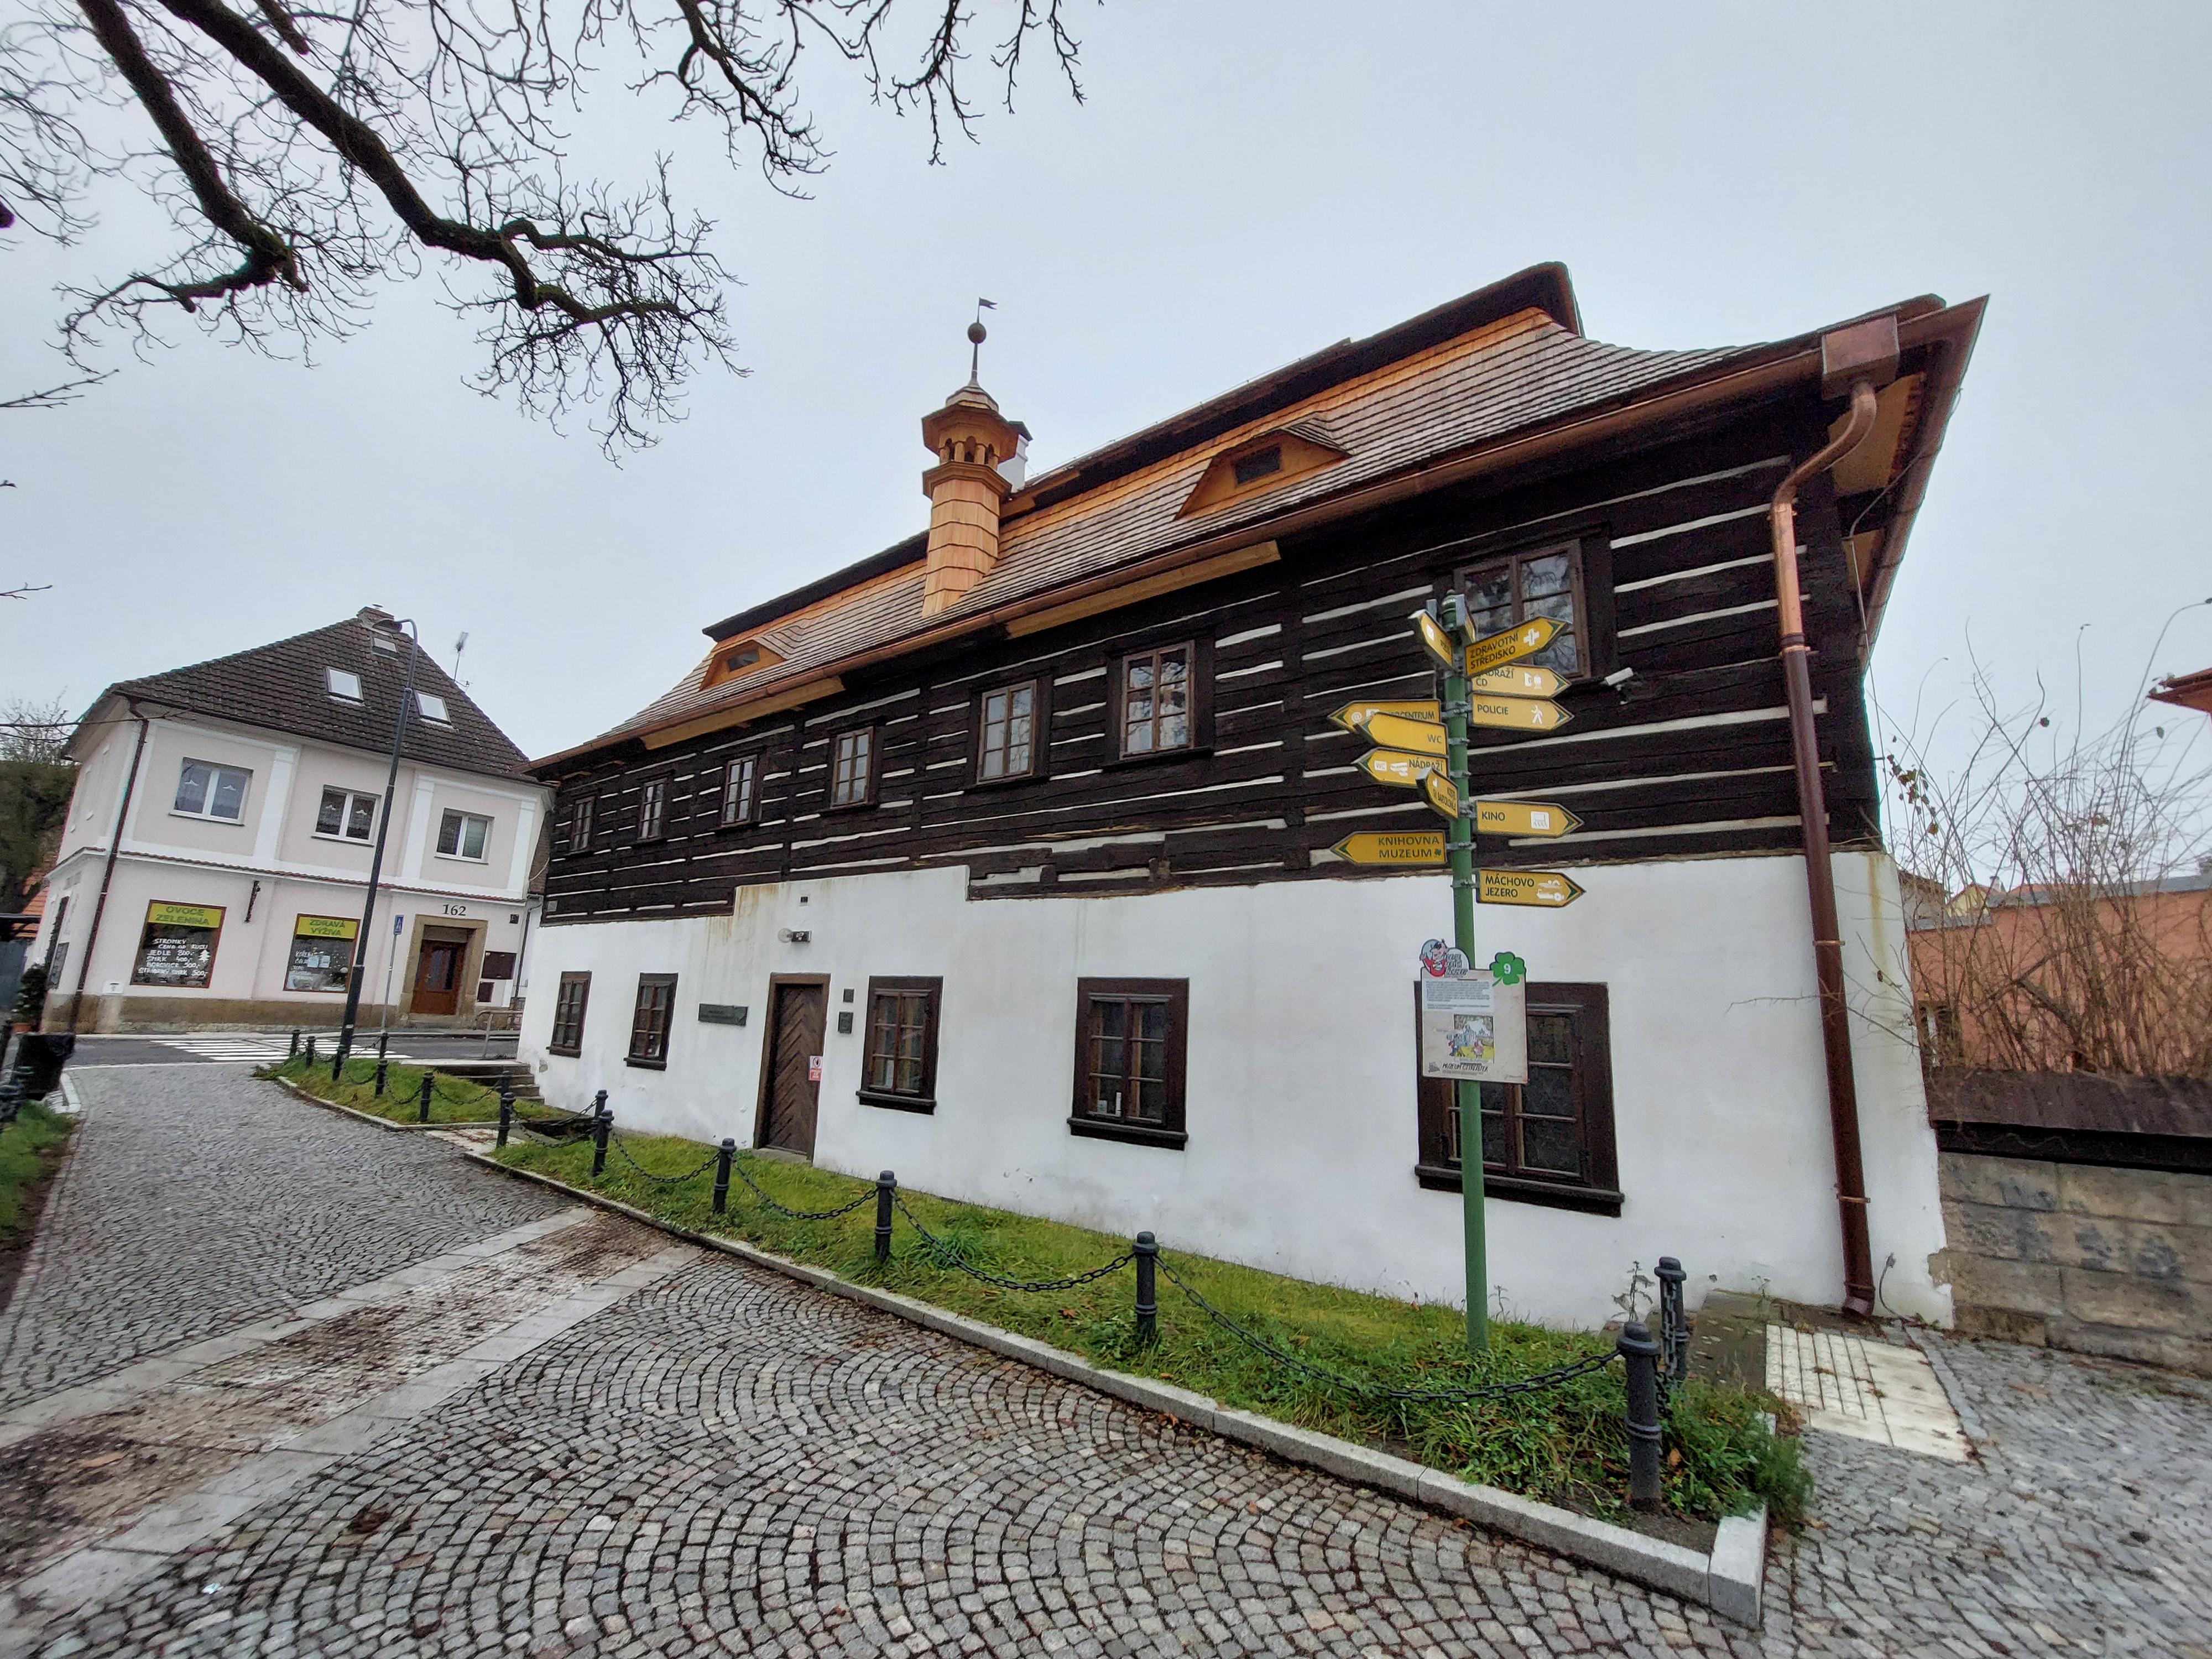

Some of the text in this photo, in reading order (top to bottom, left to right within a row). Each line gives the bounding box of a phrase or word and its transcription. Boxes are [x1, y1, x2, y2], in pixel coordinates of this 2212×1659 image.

[1470, 630, 1519, 659] ZDRAVOTNÍ
[1470, 645, 1516, 669] STŘEDISKO
[1477, 704, 1509, 715] POLICIE
[1427, 733, 1442, 744] WC
[1481, 811, 1505, 821] KINO
[1378, 836, 1440, 845] KNIHOVNA
[1379, 848, 1432, 858] MUZEUM
[1485, 874, 1535, 888] MÁCHOVO
[1485, 888, 1518, 898] JEZERO
[166, 906, 205, 916] OVOCE
[442, 904, 466, 916] 162
[155, 914, 209, 925] ZELENINA
[1504, 964, 1511, 974] 9
